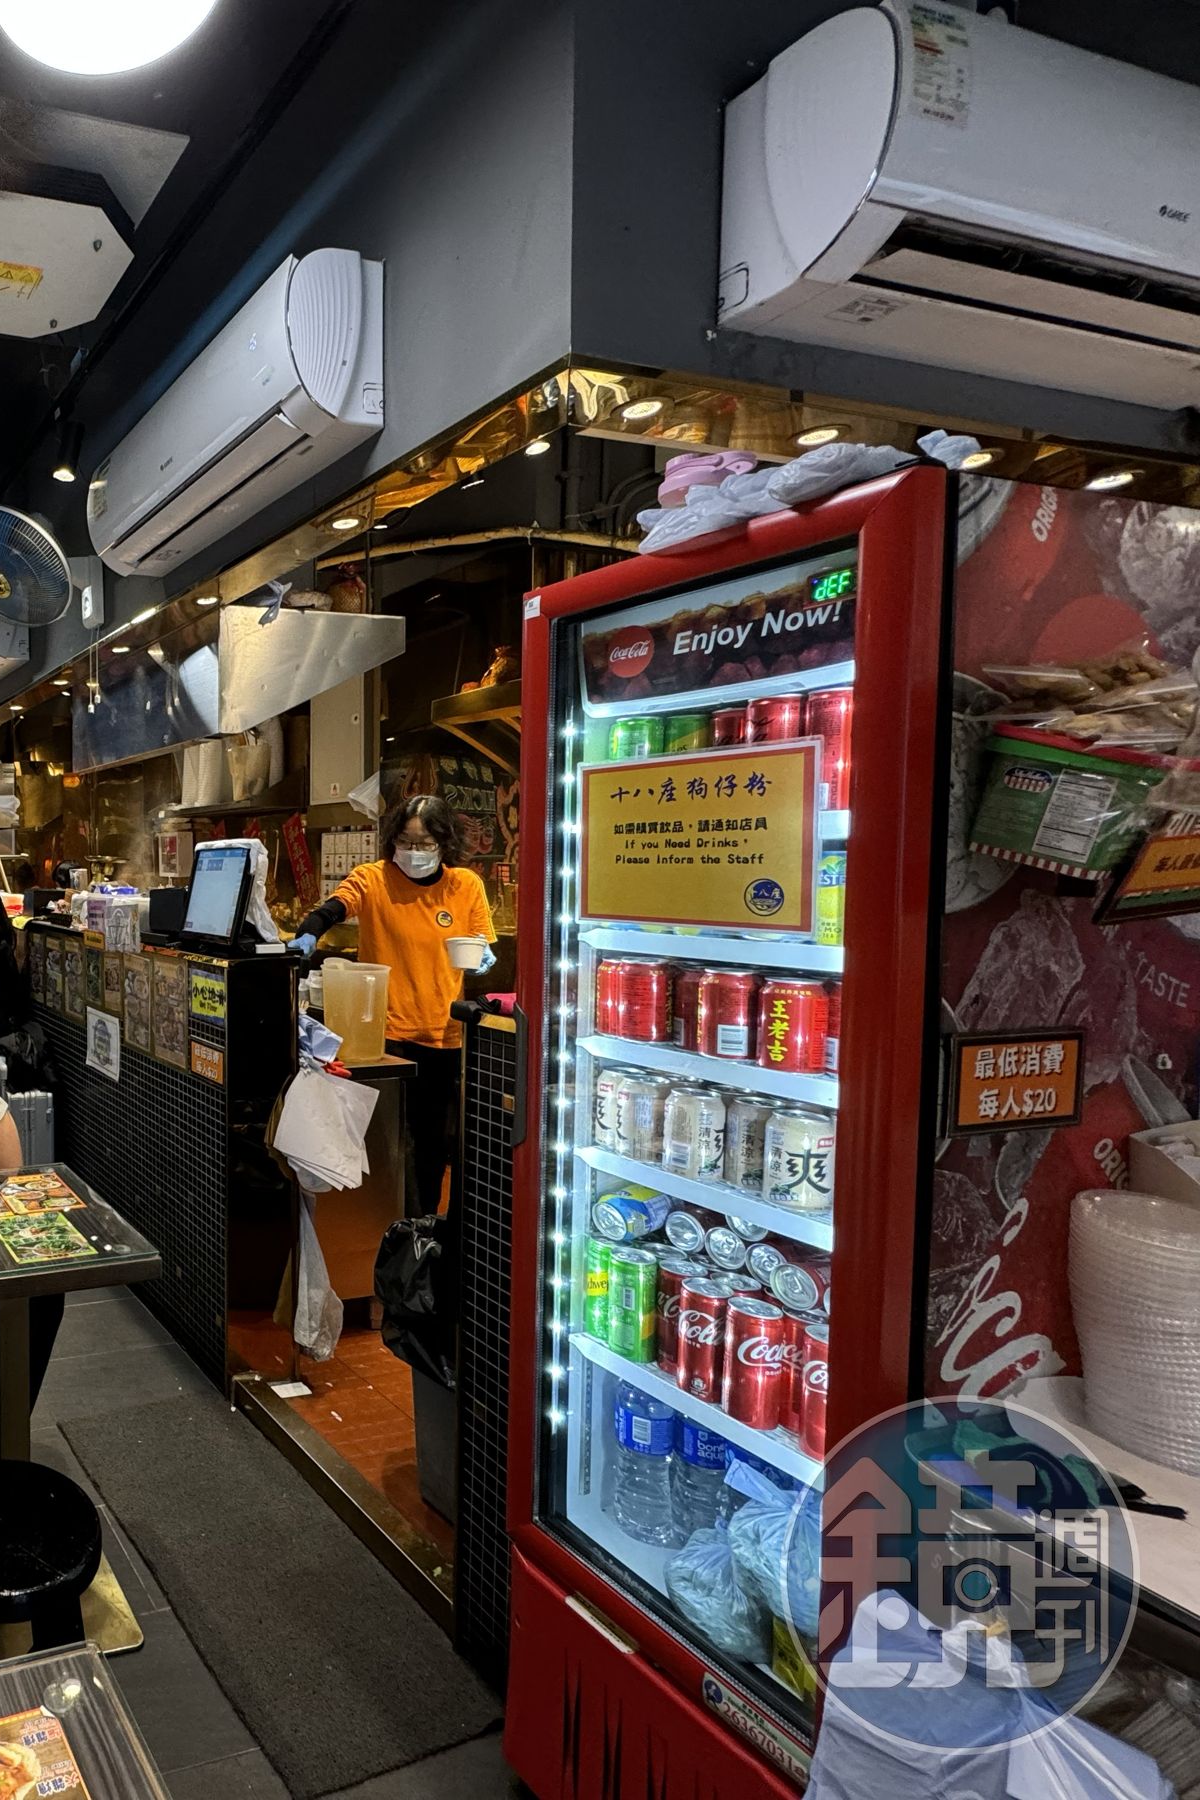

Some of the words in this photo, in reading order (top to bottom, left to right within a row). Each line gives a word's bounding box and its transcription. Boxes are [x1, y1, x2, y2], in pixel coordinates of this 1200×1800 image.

[672, 622, 753, 655] Enjoy
[761, 601, 843, 637] Now!
[610, 771, 772, 805] 十八座狗仔粉
[615, 855, 650, 864] Please
[656, 855, 693, 864] Inform
[700, 855, 720, 864] the
[727, 854, 765, 864] Staff
[625, 840, 635, 849] If
[641, 841, 659, 850] you
[664, 838, 690, 848] Need
[767, 999, 790, 1063] 王老吉
[974, 1043, 1065, 1080] 最低消費
[978, 1086, 1057, 1118] 每人$20
[785, 1134, 832, 1194] 爽
